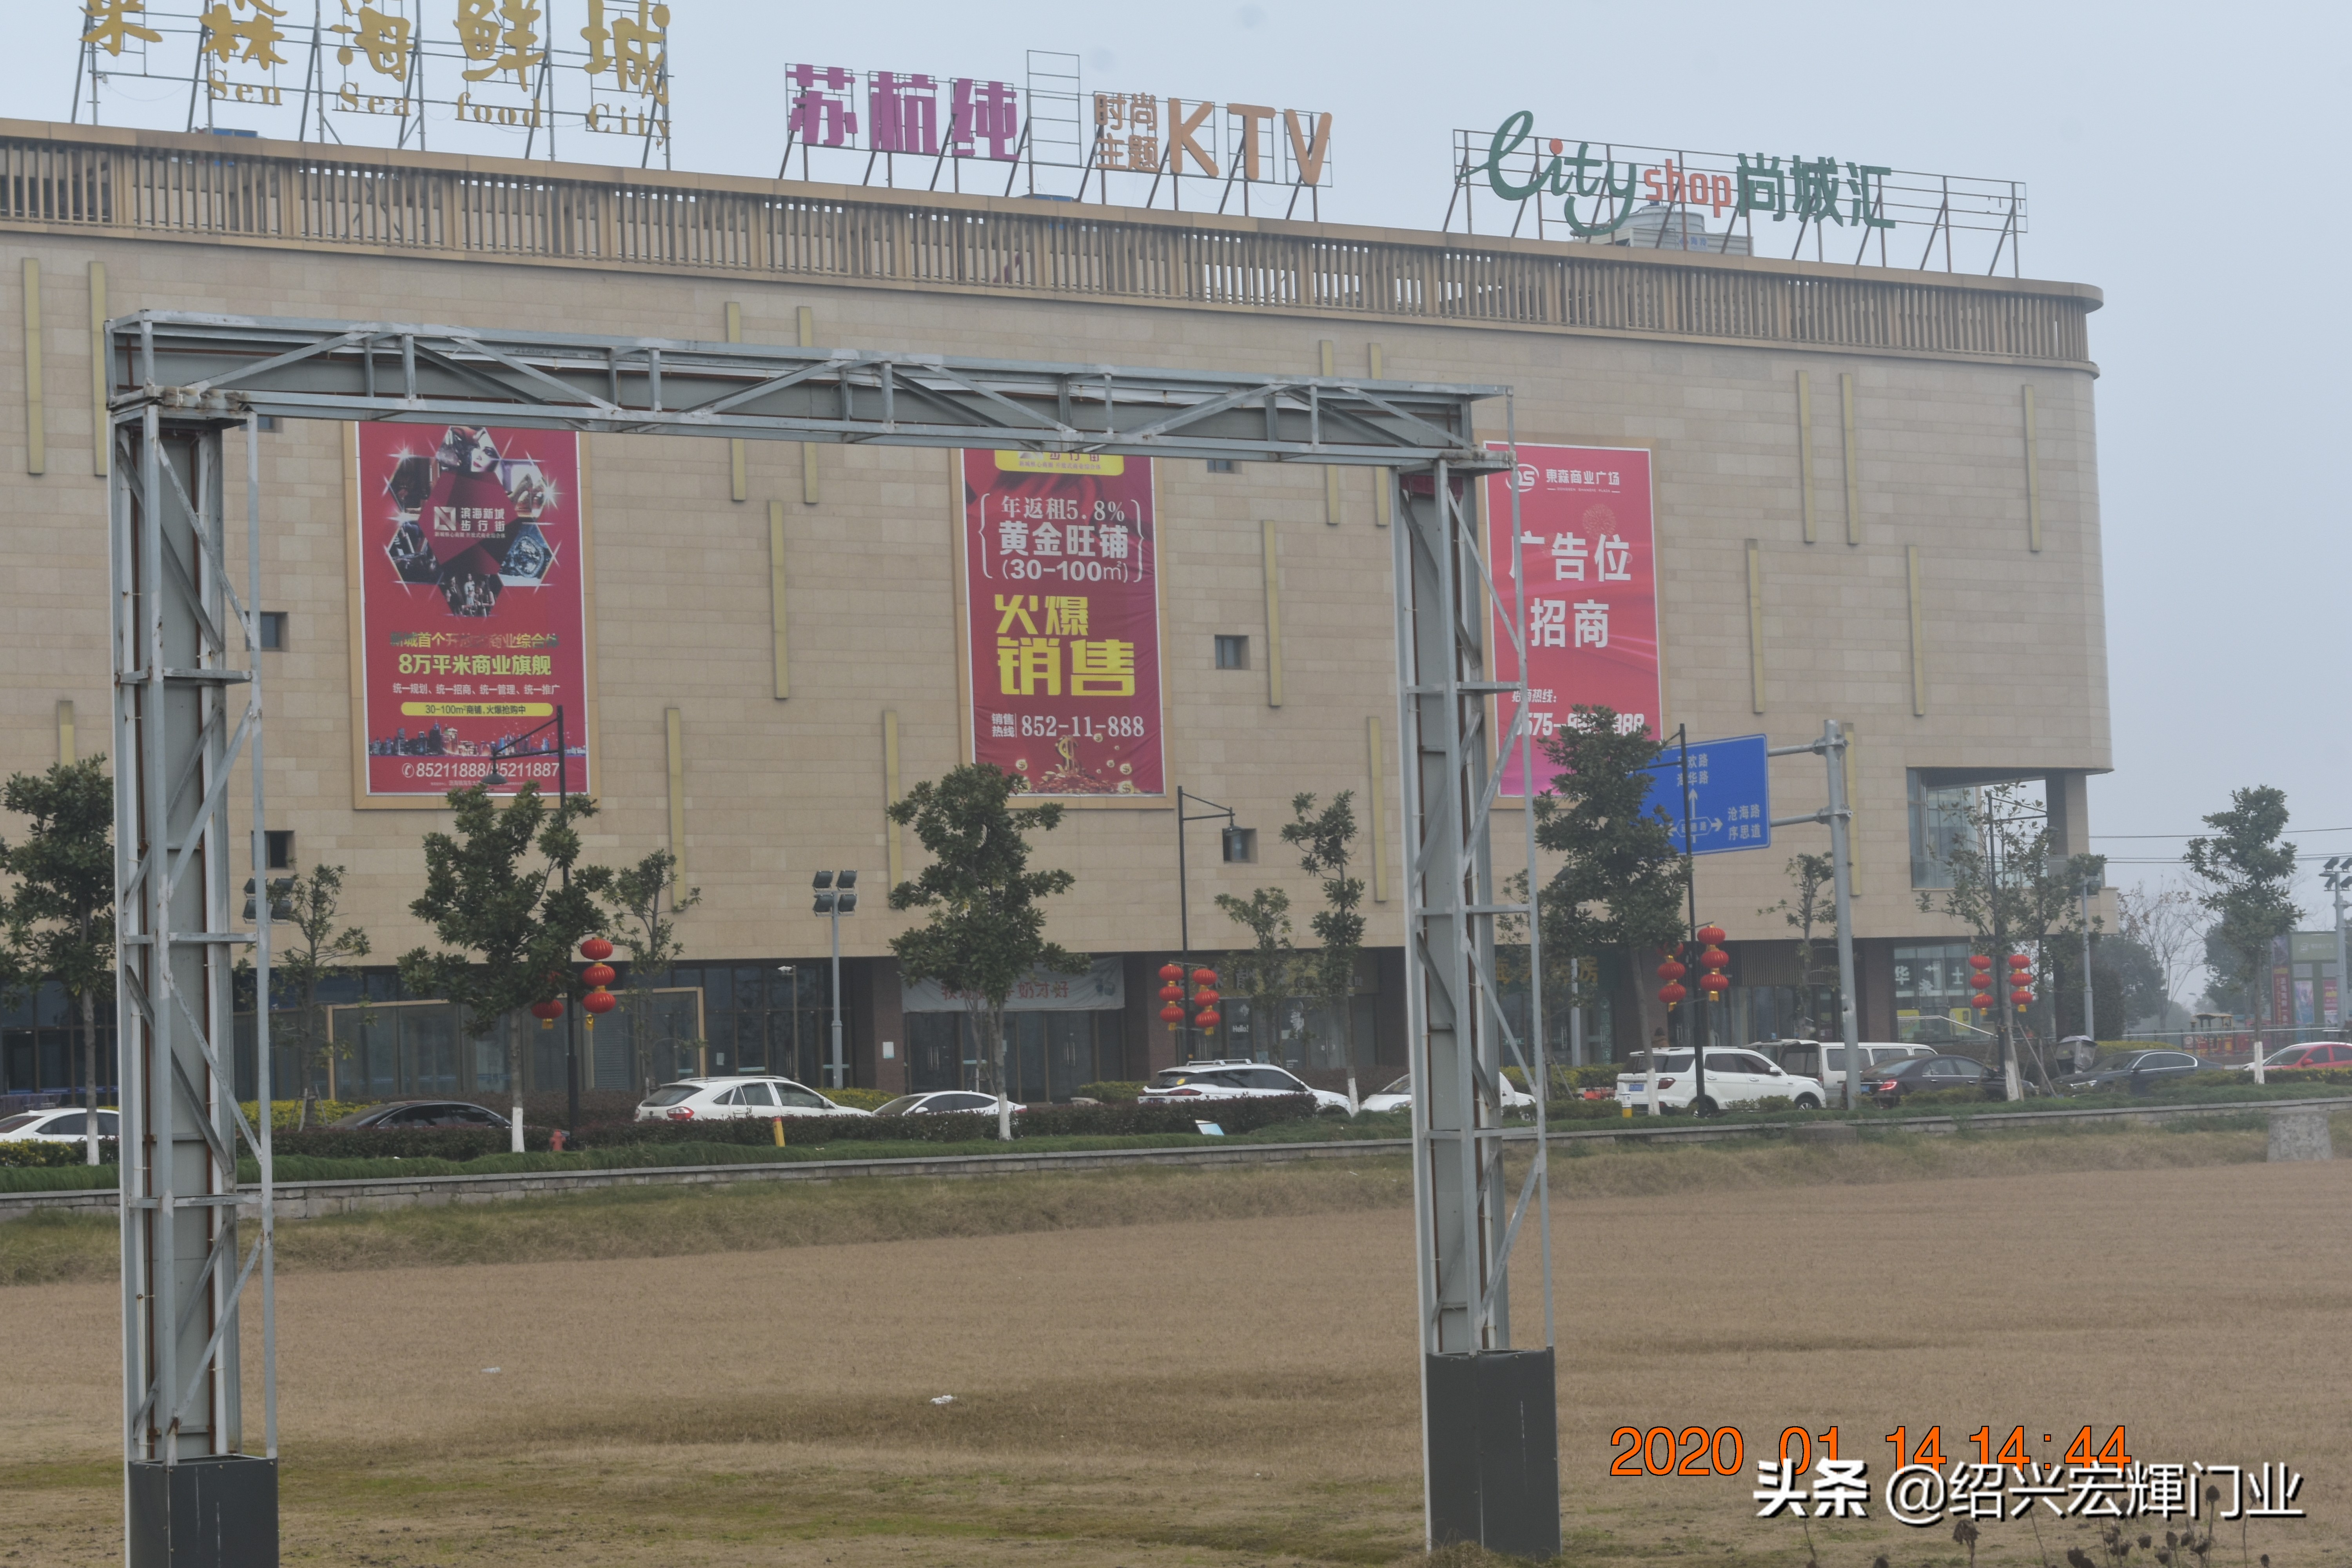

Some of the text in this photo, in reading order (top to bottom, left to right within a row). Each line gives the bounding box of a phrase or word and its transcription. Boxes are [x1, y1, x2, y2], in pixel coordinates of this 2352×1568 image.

[208, 69, 671, 149] Sen Sea food City
[786, 64, 1018, 161] 苏杭纯
[1096, 92, 1158, 131] 时尚
[1097, 132, 1159, 173] 主题
[1168, 98, 1332, 185] KTV
[1457, 110, 1896, 236] City shop 尚城汇
[1546, 468, 1620, 486] 東森商业广场
[461, 507, 505, 519] 滨海新城
[461, 519, 505, 532] 步行街
[1001, 495, 1125, 522] 年返租5.8%
[998, 520, 1129, 559] 黄金旺铺
[1509, 530, 1631, 582] 广告位
[995, 594, 1089, 636] 火爆
[1530, 597, 1609, 648] 招商
[399, 653, 552, 675] 8万平米商业旗舰
[997, 637, 1135, 696] 销售
[991, 713, 1014, 725] 销售
[992, 726, 1015, 737] 热线
[1021, 715, 1145, 737] 852-11-888
